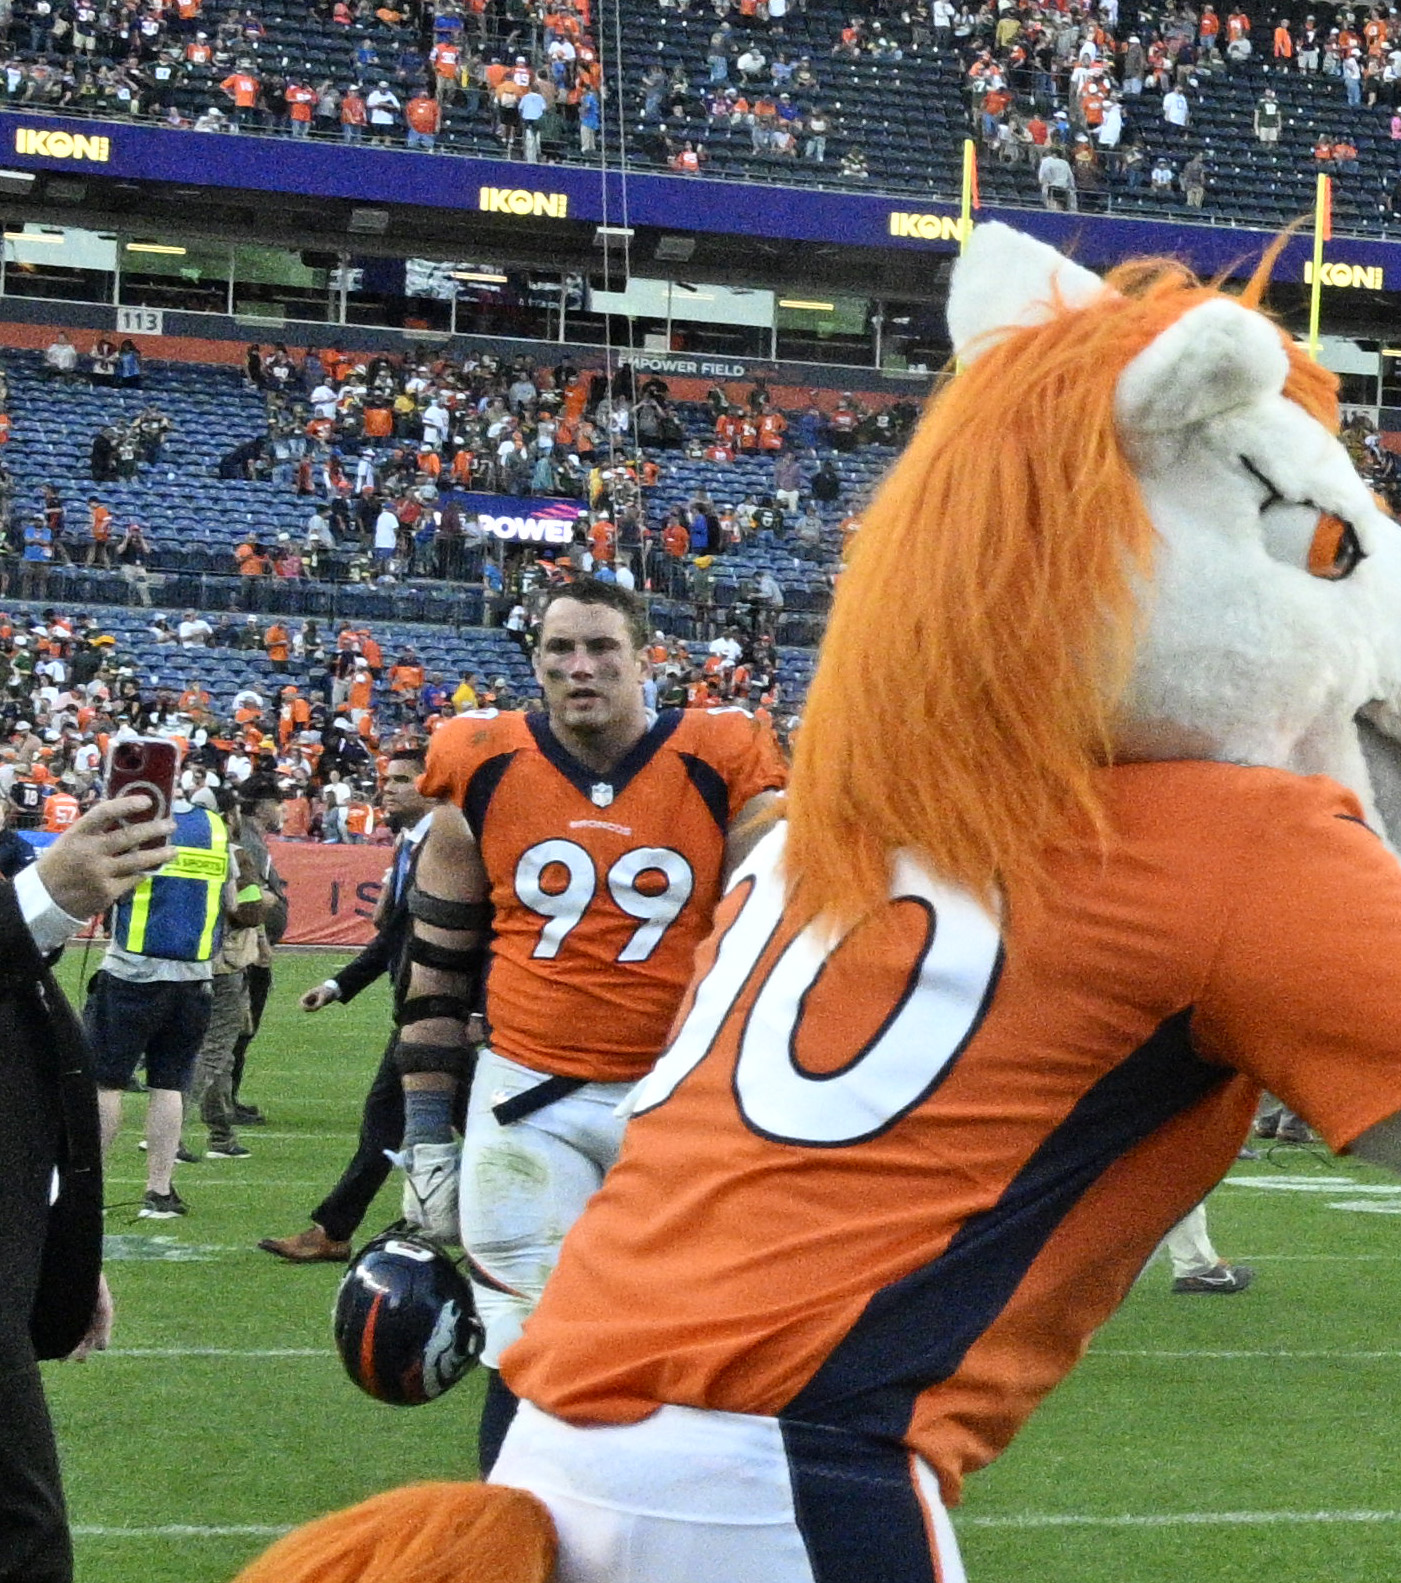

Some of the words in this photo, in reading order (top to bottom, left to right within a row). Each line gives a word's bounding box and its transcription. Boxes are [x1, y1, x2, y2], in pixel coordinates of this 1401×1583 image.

[16, 128, 99, 160] IKON
[480, 187, 556, 216] IKON
[122, 312, 157, 331] 113
[617, 356, 697, 374] EMPOWER
[701, 362, 745, 377] FIELD
[433, 511, 573, 543] POWE
[183, 857, 223, 871] SPORTS
[514, 838, 694, 962] 99
